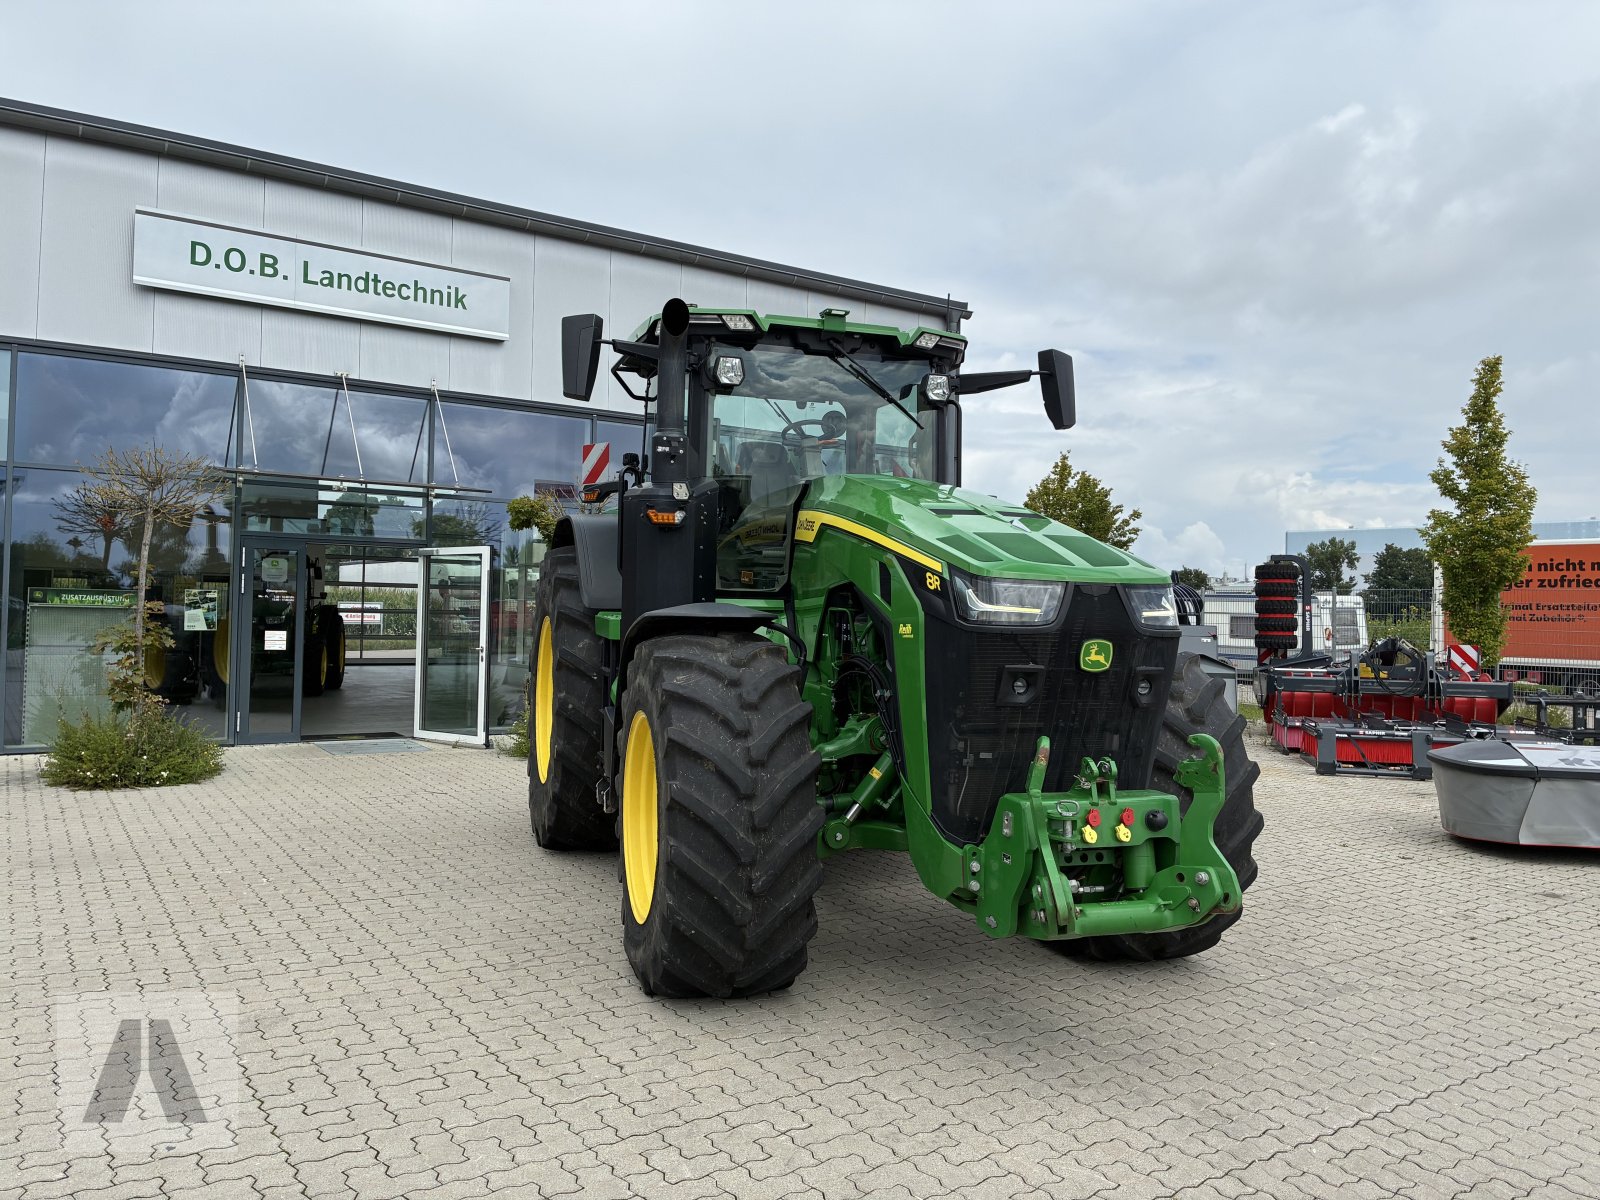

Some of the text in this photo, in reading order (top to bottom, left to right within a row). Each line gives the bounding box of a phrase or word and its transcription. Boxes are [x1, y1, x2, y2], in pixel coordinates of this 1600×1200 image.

[189, 240, 468, 311] D.O.B. Landtechnik
[1537, 558, 1586, 572] nicht
[925, 572, 941, 591] 8R
